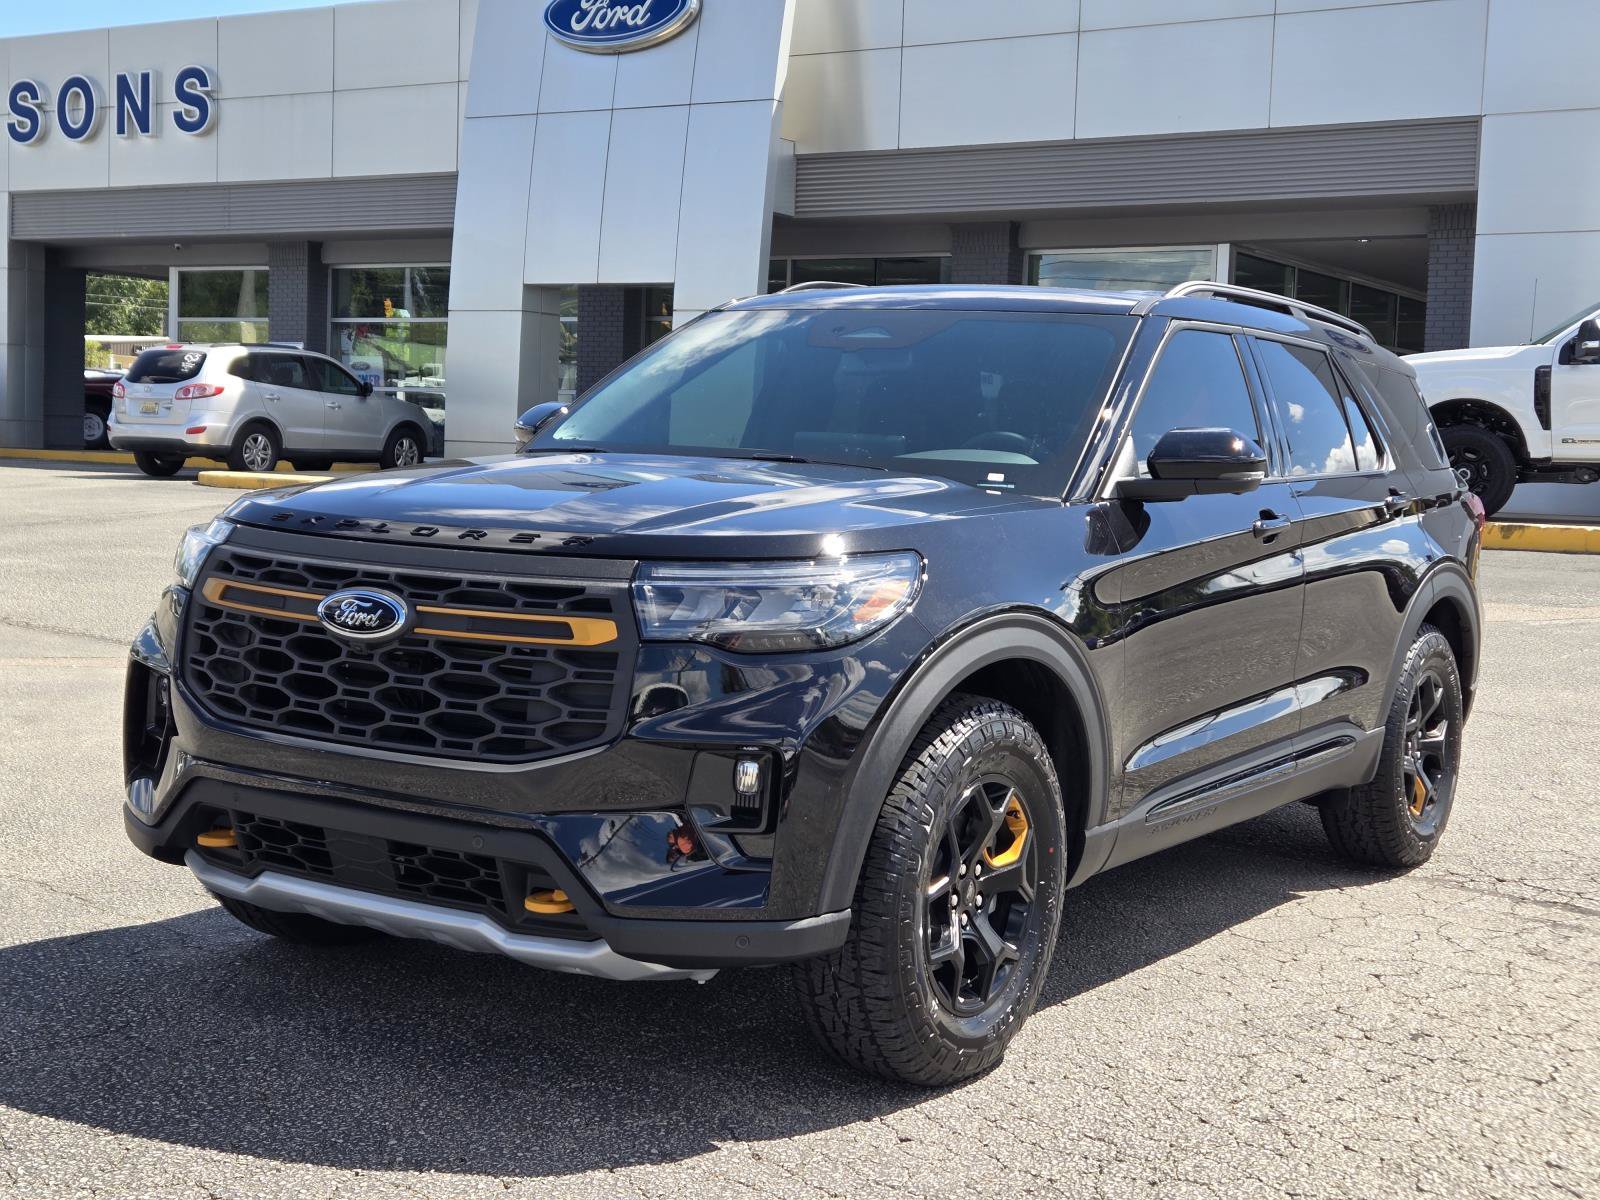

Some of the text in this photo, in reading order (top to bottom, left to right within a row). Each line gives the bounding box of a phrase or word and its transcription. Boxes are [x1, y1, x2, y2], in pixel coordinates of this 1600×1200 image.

[571, 0, 650, 31] Ford
[7, 65, 212, 144] SONS
[271, 512, 594, 546] EXPLORER
[334, 599, 383, 628] Ford
